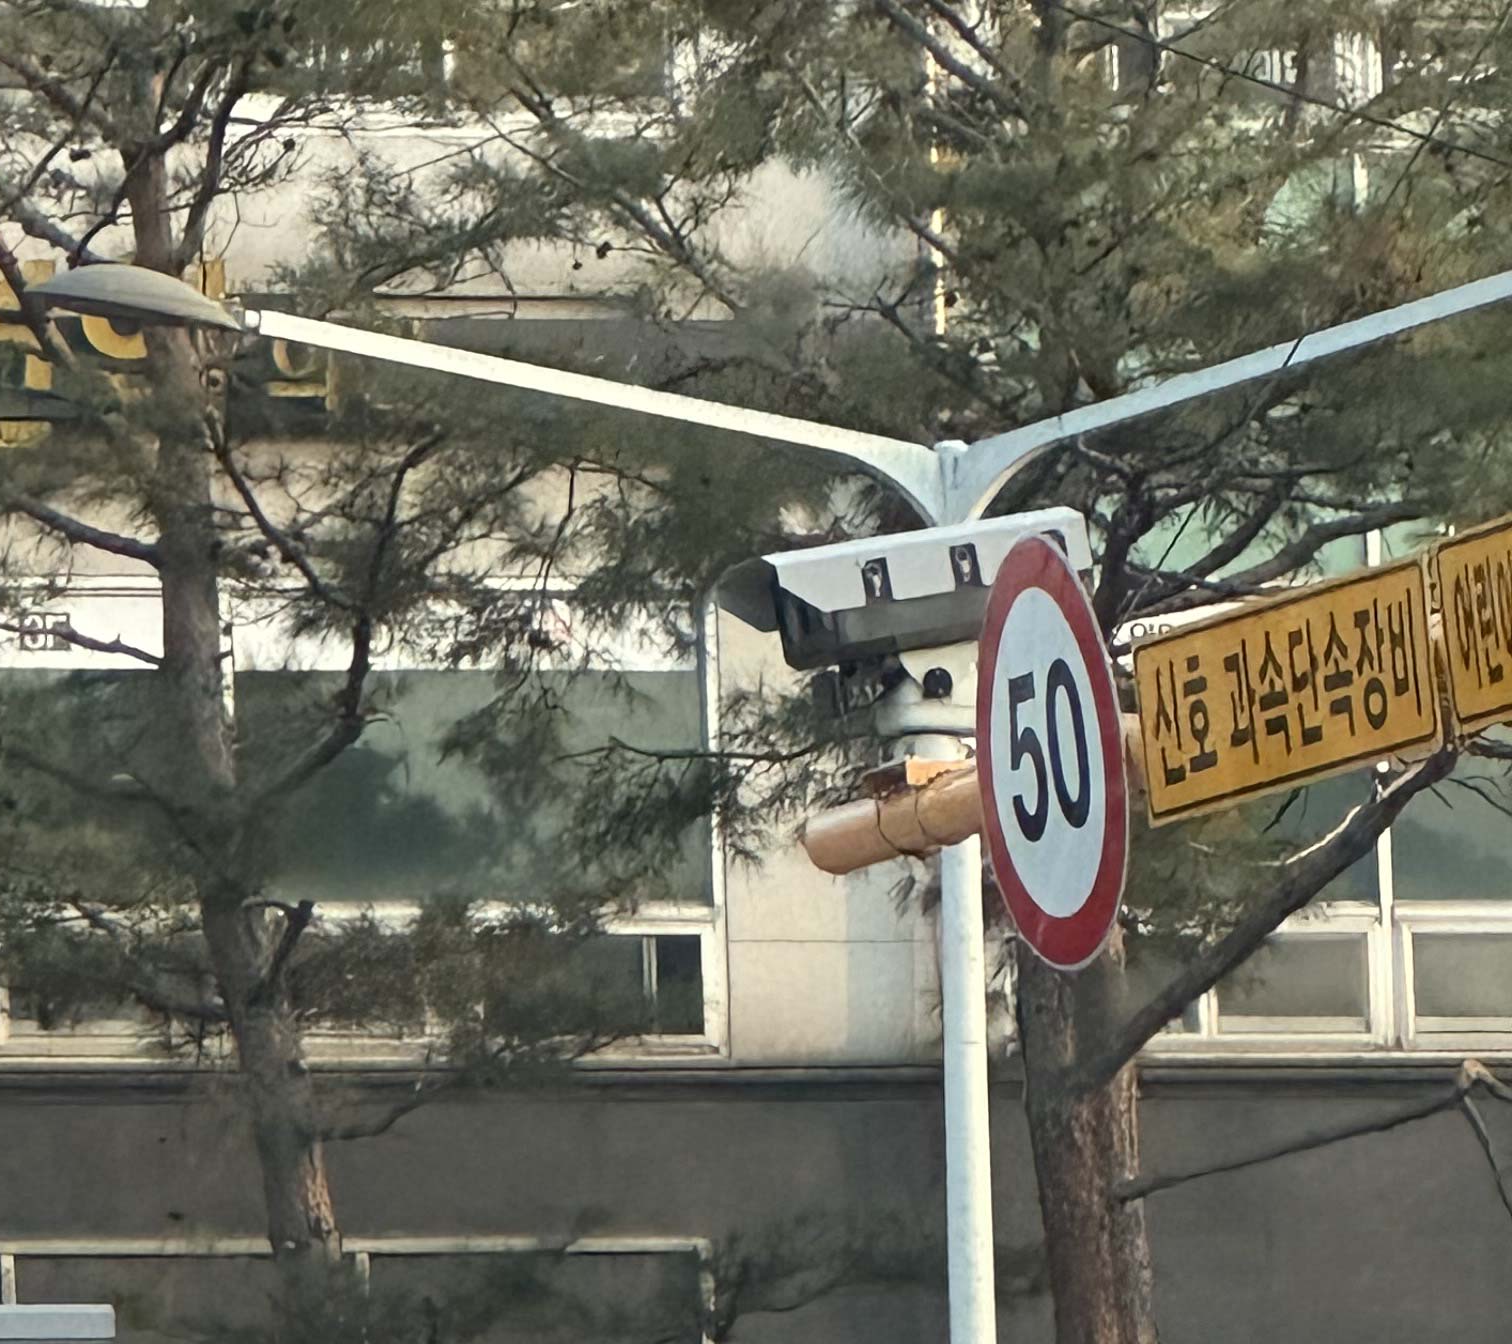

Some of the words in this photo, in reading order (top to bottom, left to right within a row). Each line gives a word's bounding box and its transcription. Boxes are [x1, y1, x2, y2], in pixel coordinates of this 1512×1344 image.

[1008, 658, 1091, 842] 50
[1154, 654, 1218, 788] 신호
[1223, 587, 1422, 765] 과속단속장비
